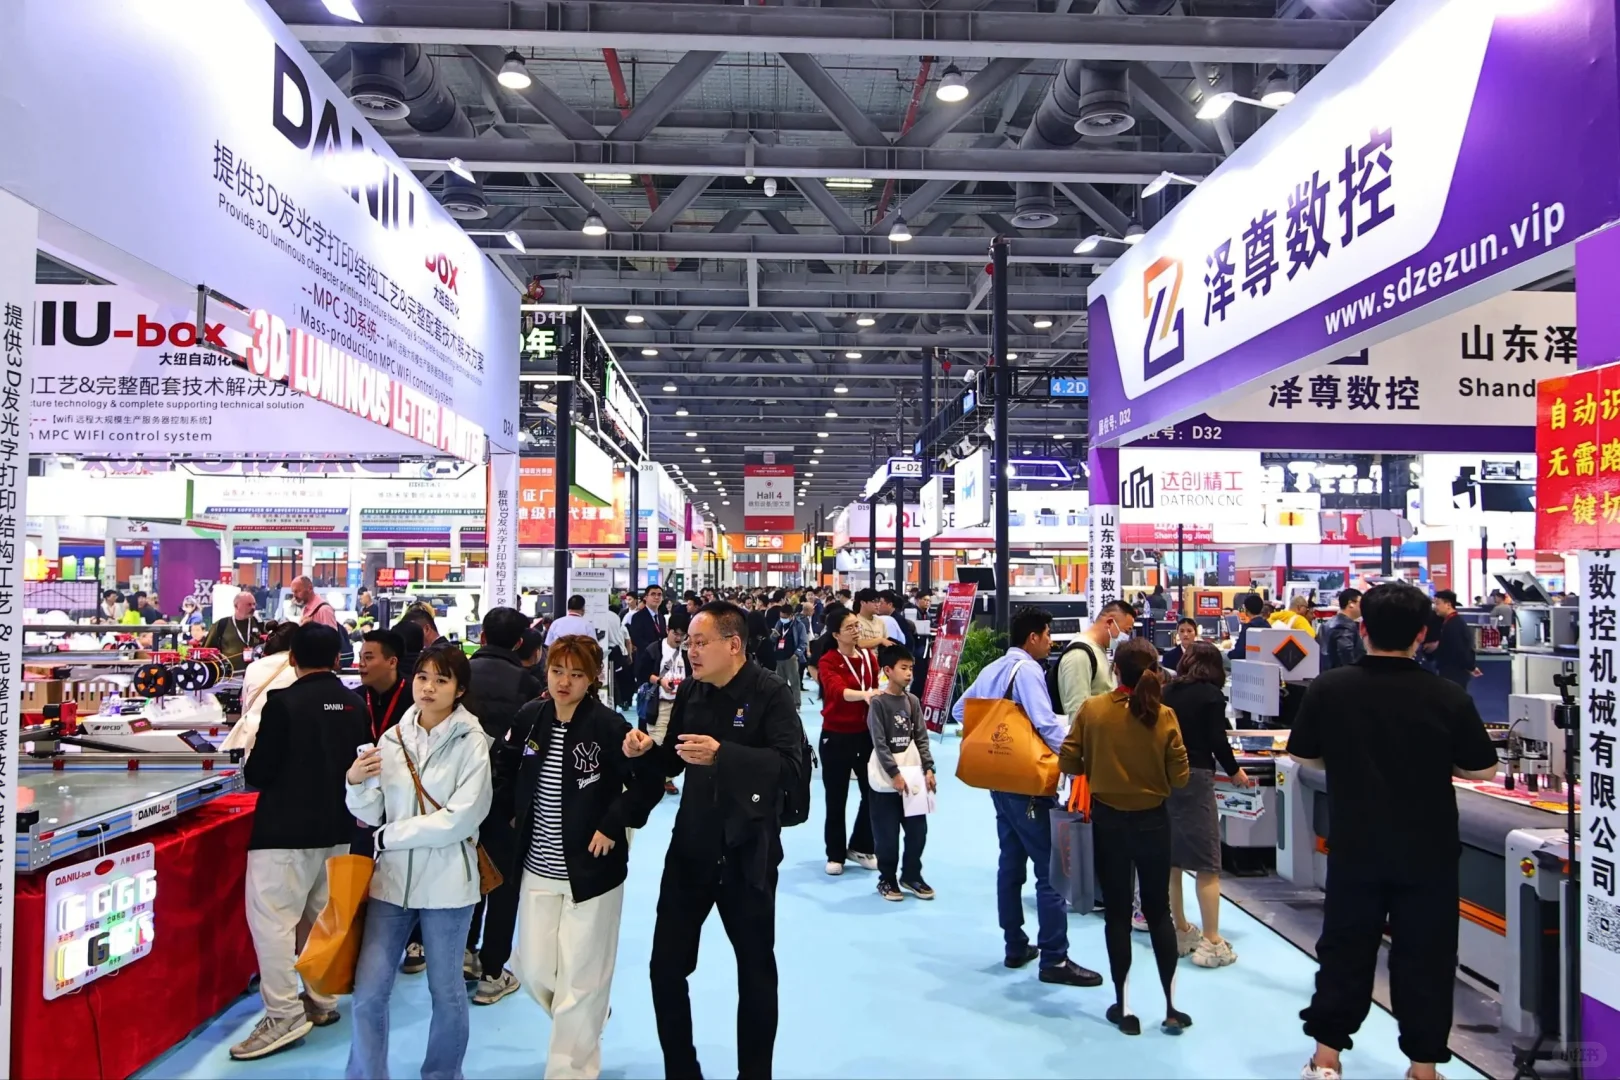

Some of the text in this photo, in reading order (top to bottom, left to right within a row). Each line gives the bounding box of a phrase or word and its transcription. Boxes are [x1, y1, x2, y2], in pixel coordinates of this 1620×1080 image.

[1202, 125, 1396, 327] 泽尊数控
[219, 192, 255, 230] Provide
[256, 220, 269, 239] 3D
[270, 229, 306, 265] luminous
[307, 257, 340, 287] character
[340, 280, 363, 307] printing
[1325, 201, 1566, 335] www.sdzezun.vip
[534, 311, 566, 324] D11
[300, 306, 377, 364] Mass-production
[380, 353, 395, 374] MPC
[397, 363, 412, 383] WIFI
[413, 375, 434, 396] control
[1461, 325, 1577, 364] 山东泽
[158, 353, 232, 366] 大纽自动化
[247, 309, 287, 381] 3D
[289, 328, 391, 427] LUMINOUS
[1268, 375, 1420, 410] 泽尊数控
[1458, 377, 1536, 398] Shand
[54, 399, 107, 409] technology
[110, 400, 117, 408] &
[119, 400, 164, 409] complete
[166, 400, 218, 410] supporting
[220, 400, 264, 409] technical
[266, 401, 304, 409] solution
[39, 430, 69, 440] MPC
[74, 430, 104, 440] WIFI
[109, 430, 160, 441] control
[163, 431, 212, 443] system
[503, 418, 514, 438] D34
[1160, 471, 1244, 491] 达创精工
[757, 491, 782, 499] Hall 4
[1160, 494, 1243, 506] DATRON CNC
[1154, 531, 1193, 542] Shandng
[1588, 549, 1618, 897] 数控机械有限公司
[572, 741, 601, 773] NY
